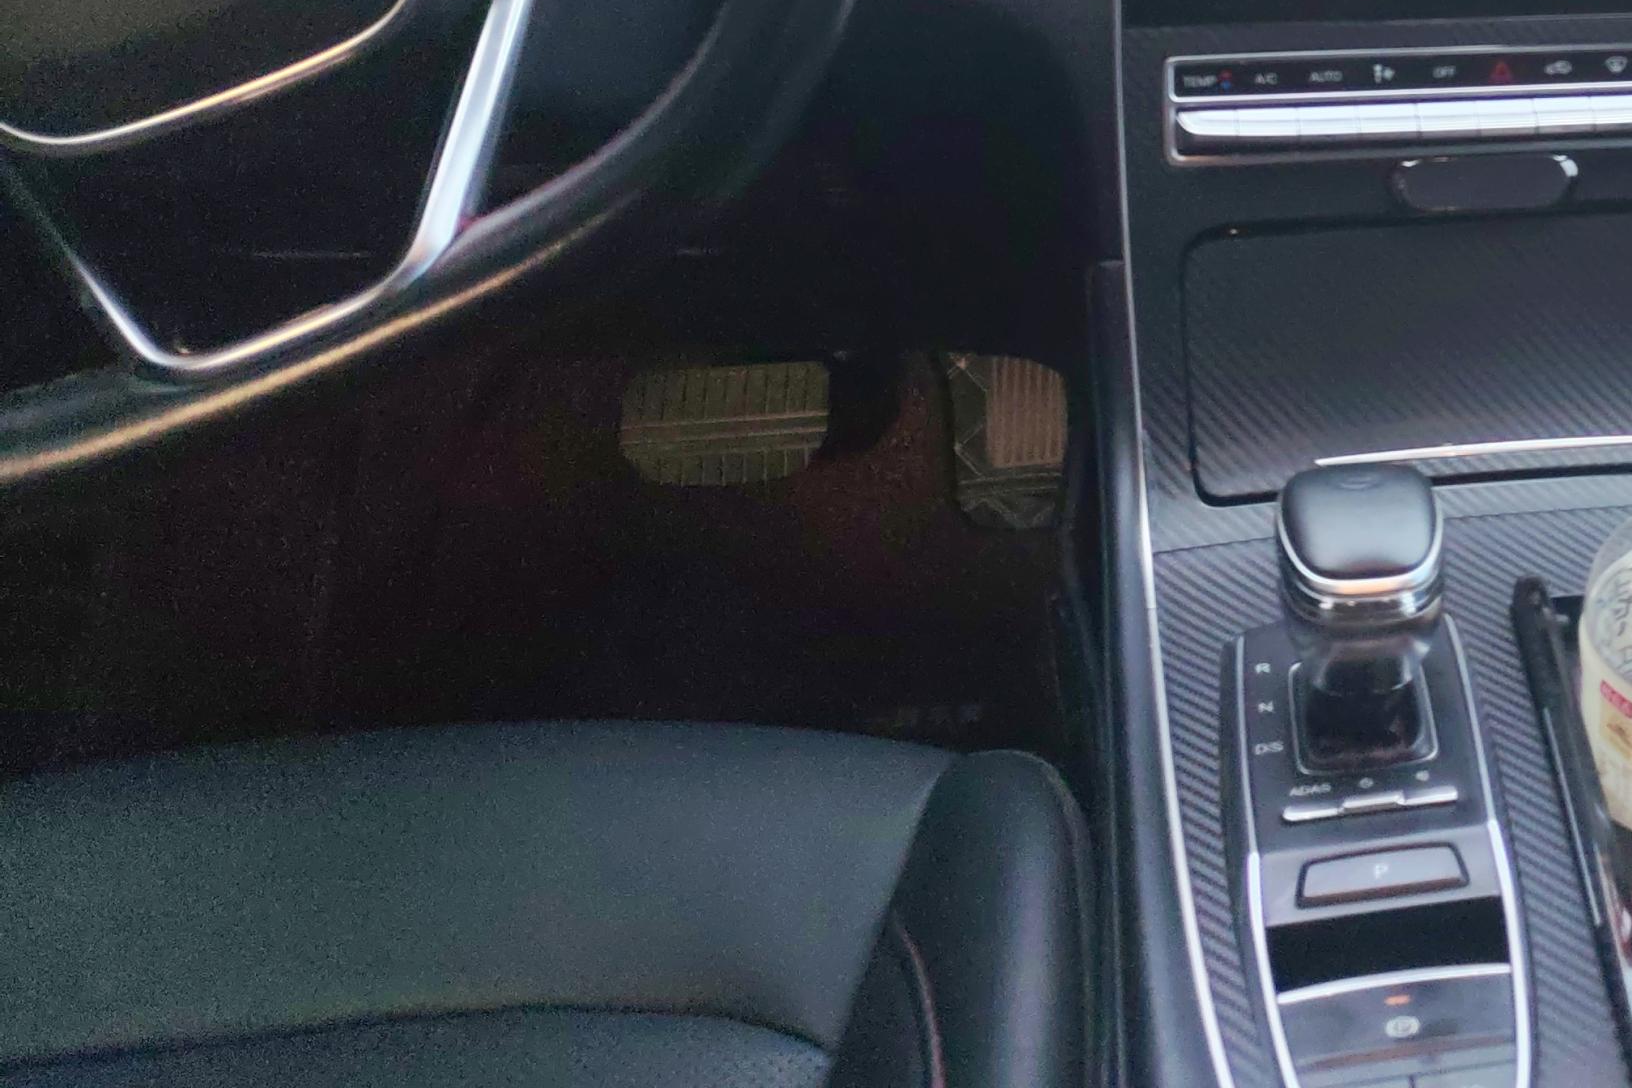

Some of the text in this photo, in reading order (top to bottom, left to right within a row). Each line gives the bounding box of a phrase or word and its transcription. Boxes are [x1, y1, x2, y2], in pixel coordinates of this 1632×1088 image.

[1309, 70, 1343, 83] AUTO
[1433, 65, 1457, 79] OFF
[1183, 75, 1217, 88] TEMP
[1255, 662, 1271, 674] R
[1257, 701, 1274, 713] N
[1374, 865, 1389, 880] P
